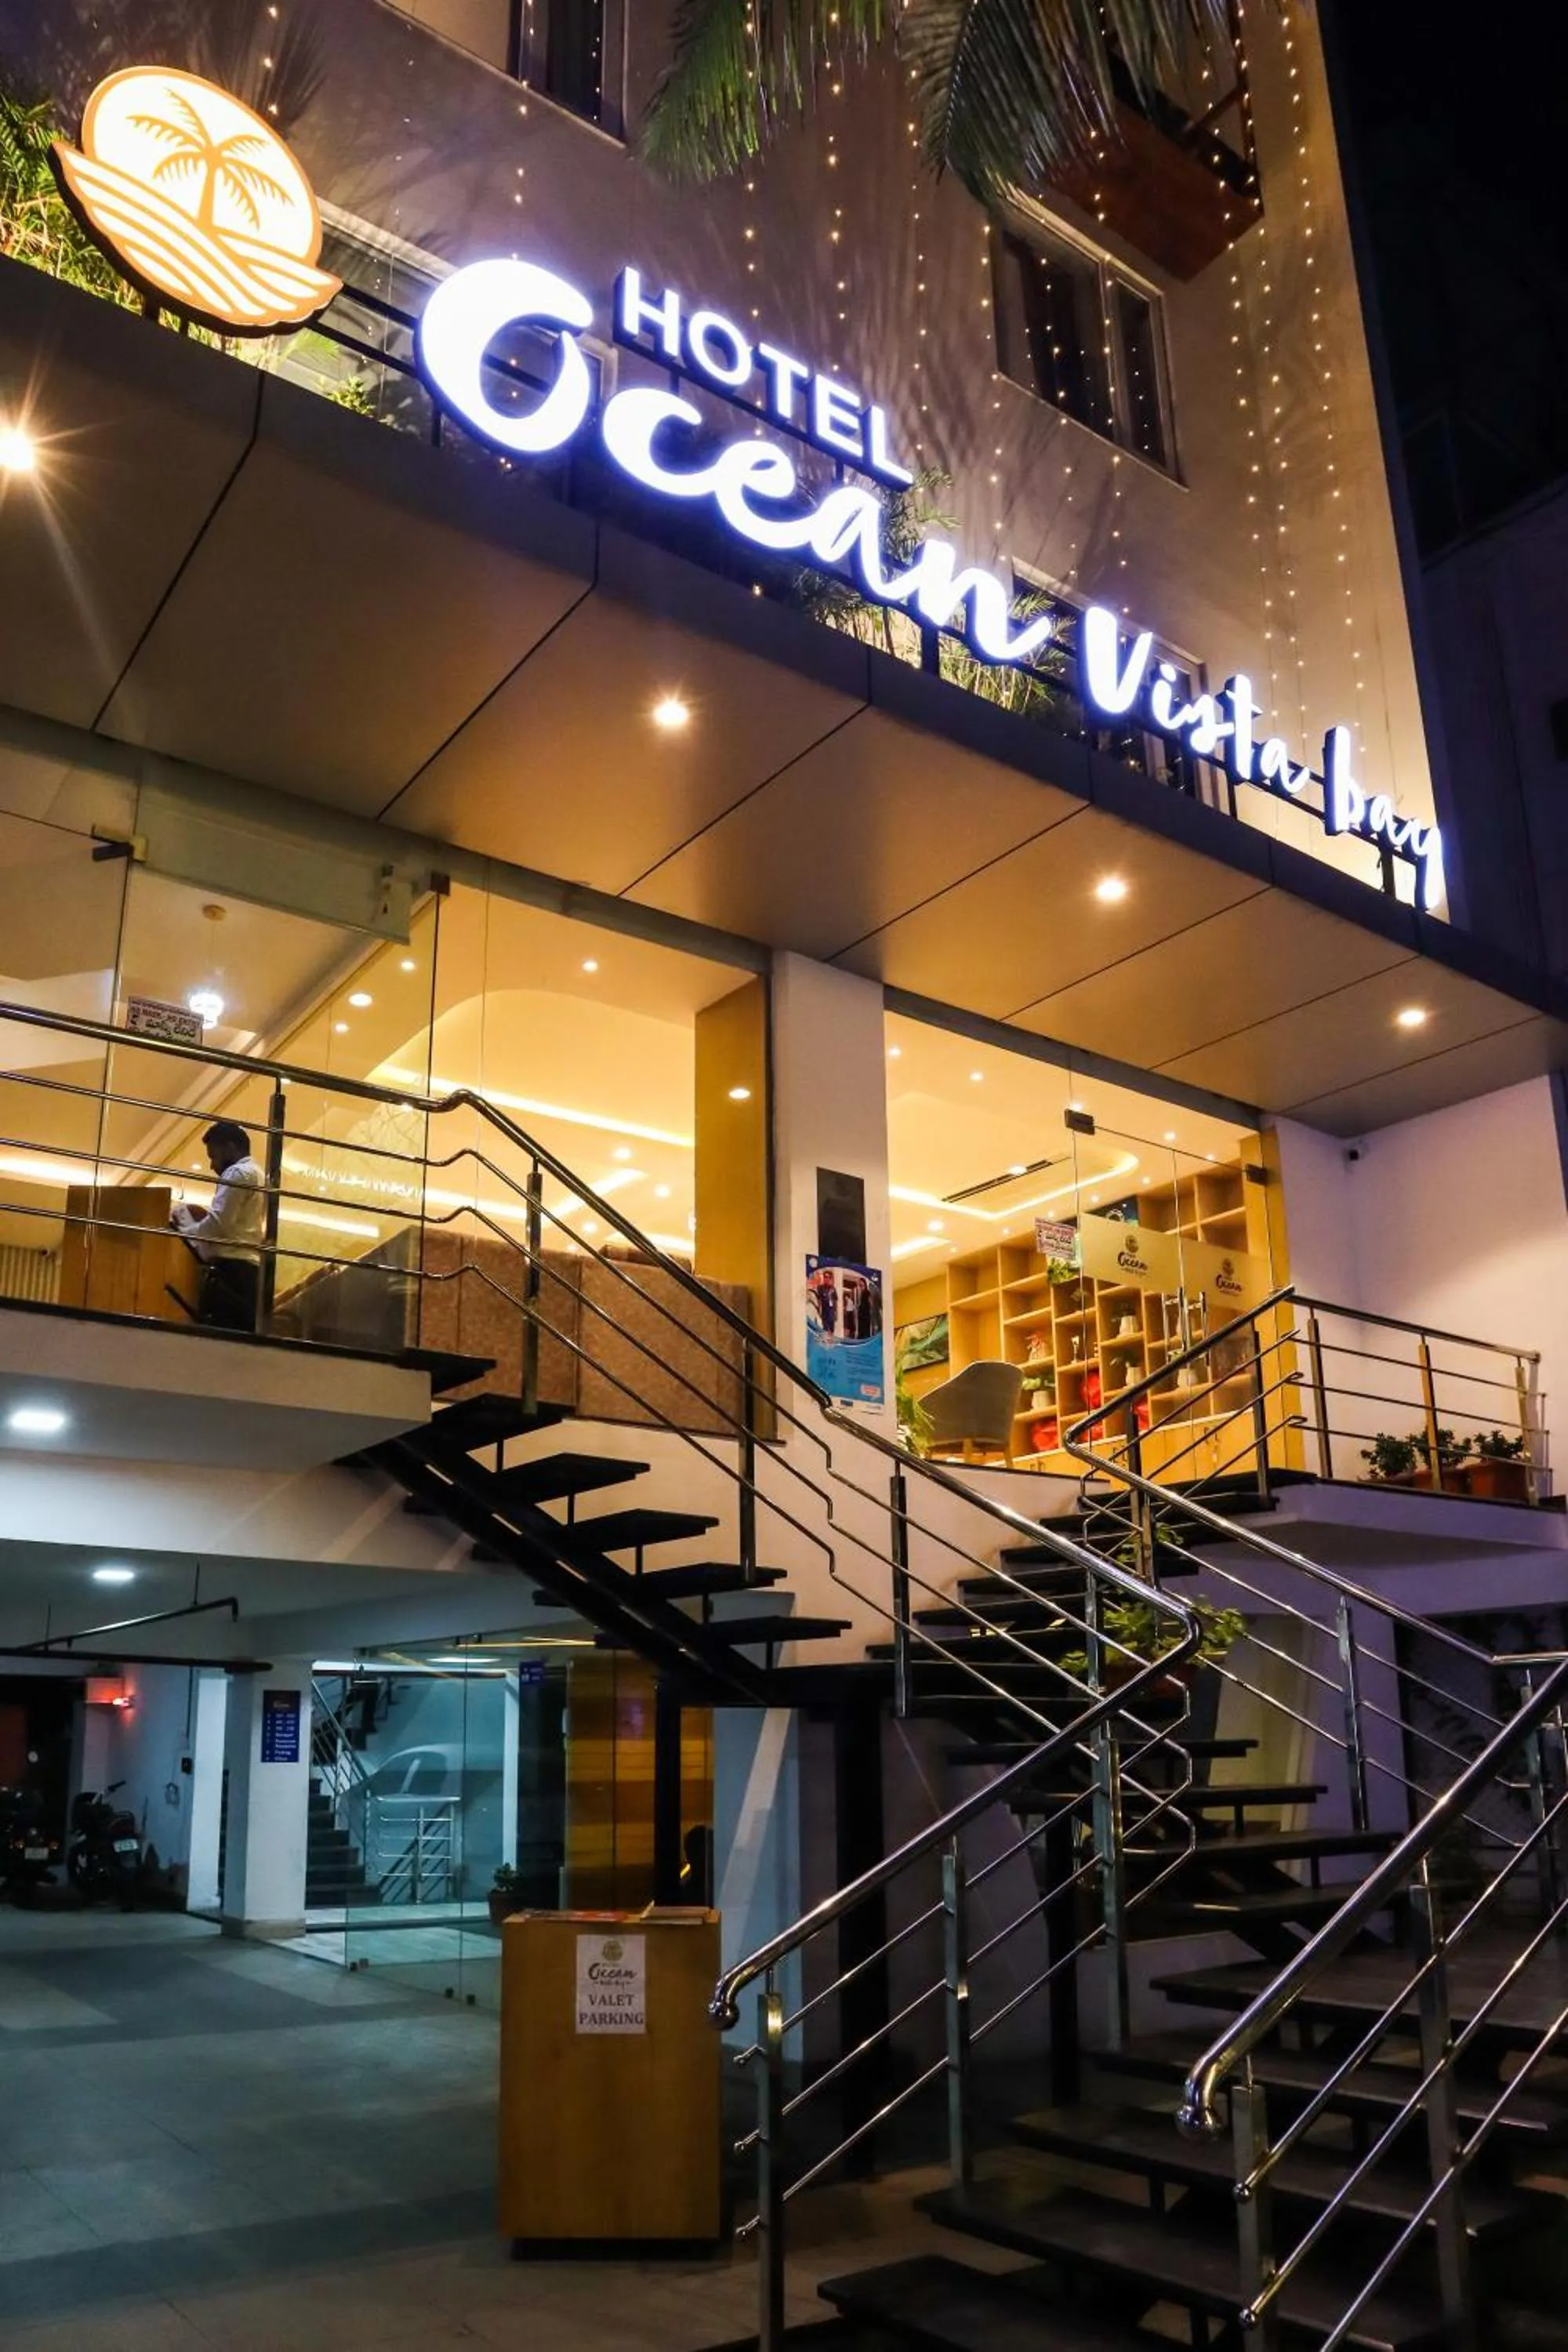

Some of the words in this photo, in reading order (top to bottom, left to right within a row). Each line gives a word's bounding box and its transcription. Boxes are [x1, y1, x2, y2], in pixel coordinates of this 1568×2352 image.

[618, 265, 913, 486] HOTEL
[419, 258, 1051, 659] Ocean
[1084, 606, 1311, 793] Vista
[1329, 724, 1443, 910] bay
[1117, 1250, 1149, 1271] Ocean
[1216, 1273, 1243, 1293] Ocean
[588, 1962, 637, 1980] Ocean
[588, 1994, 634, 2007] VALET
[579, 2012, 644, 2026] PARKING
